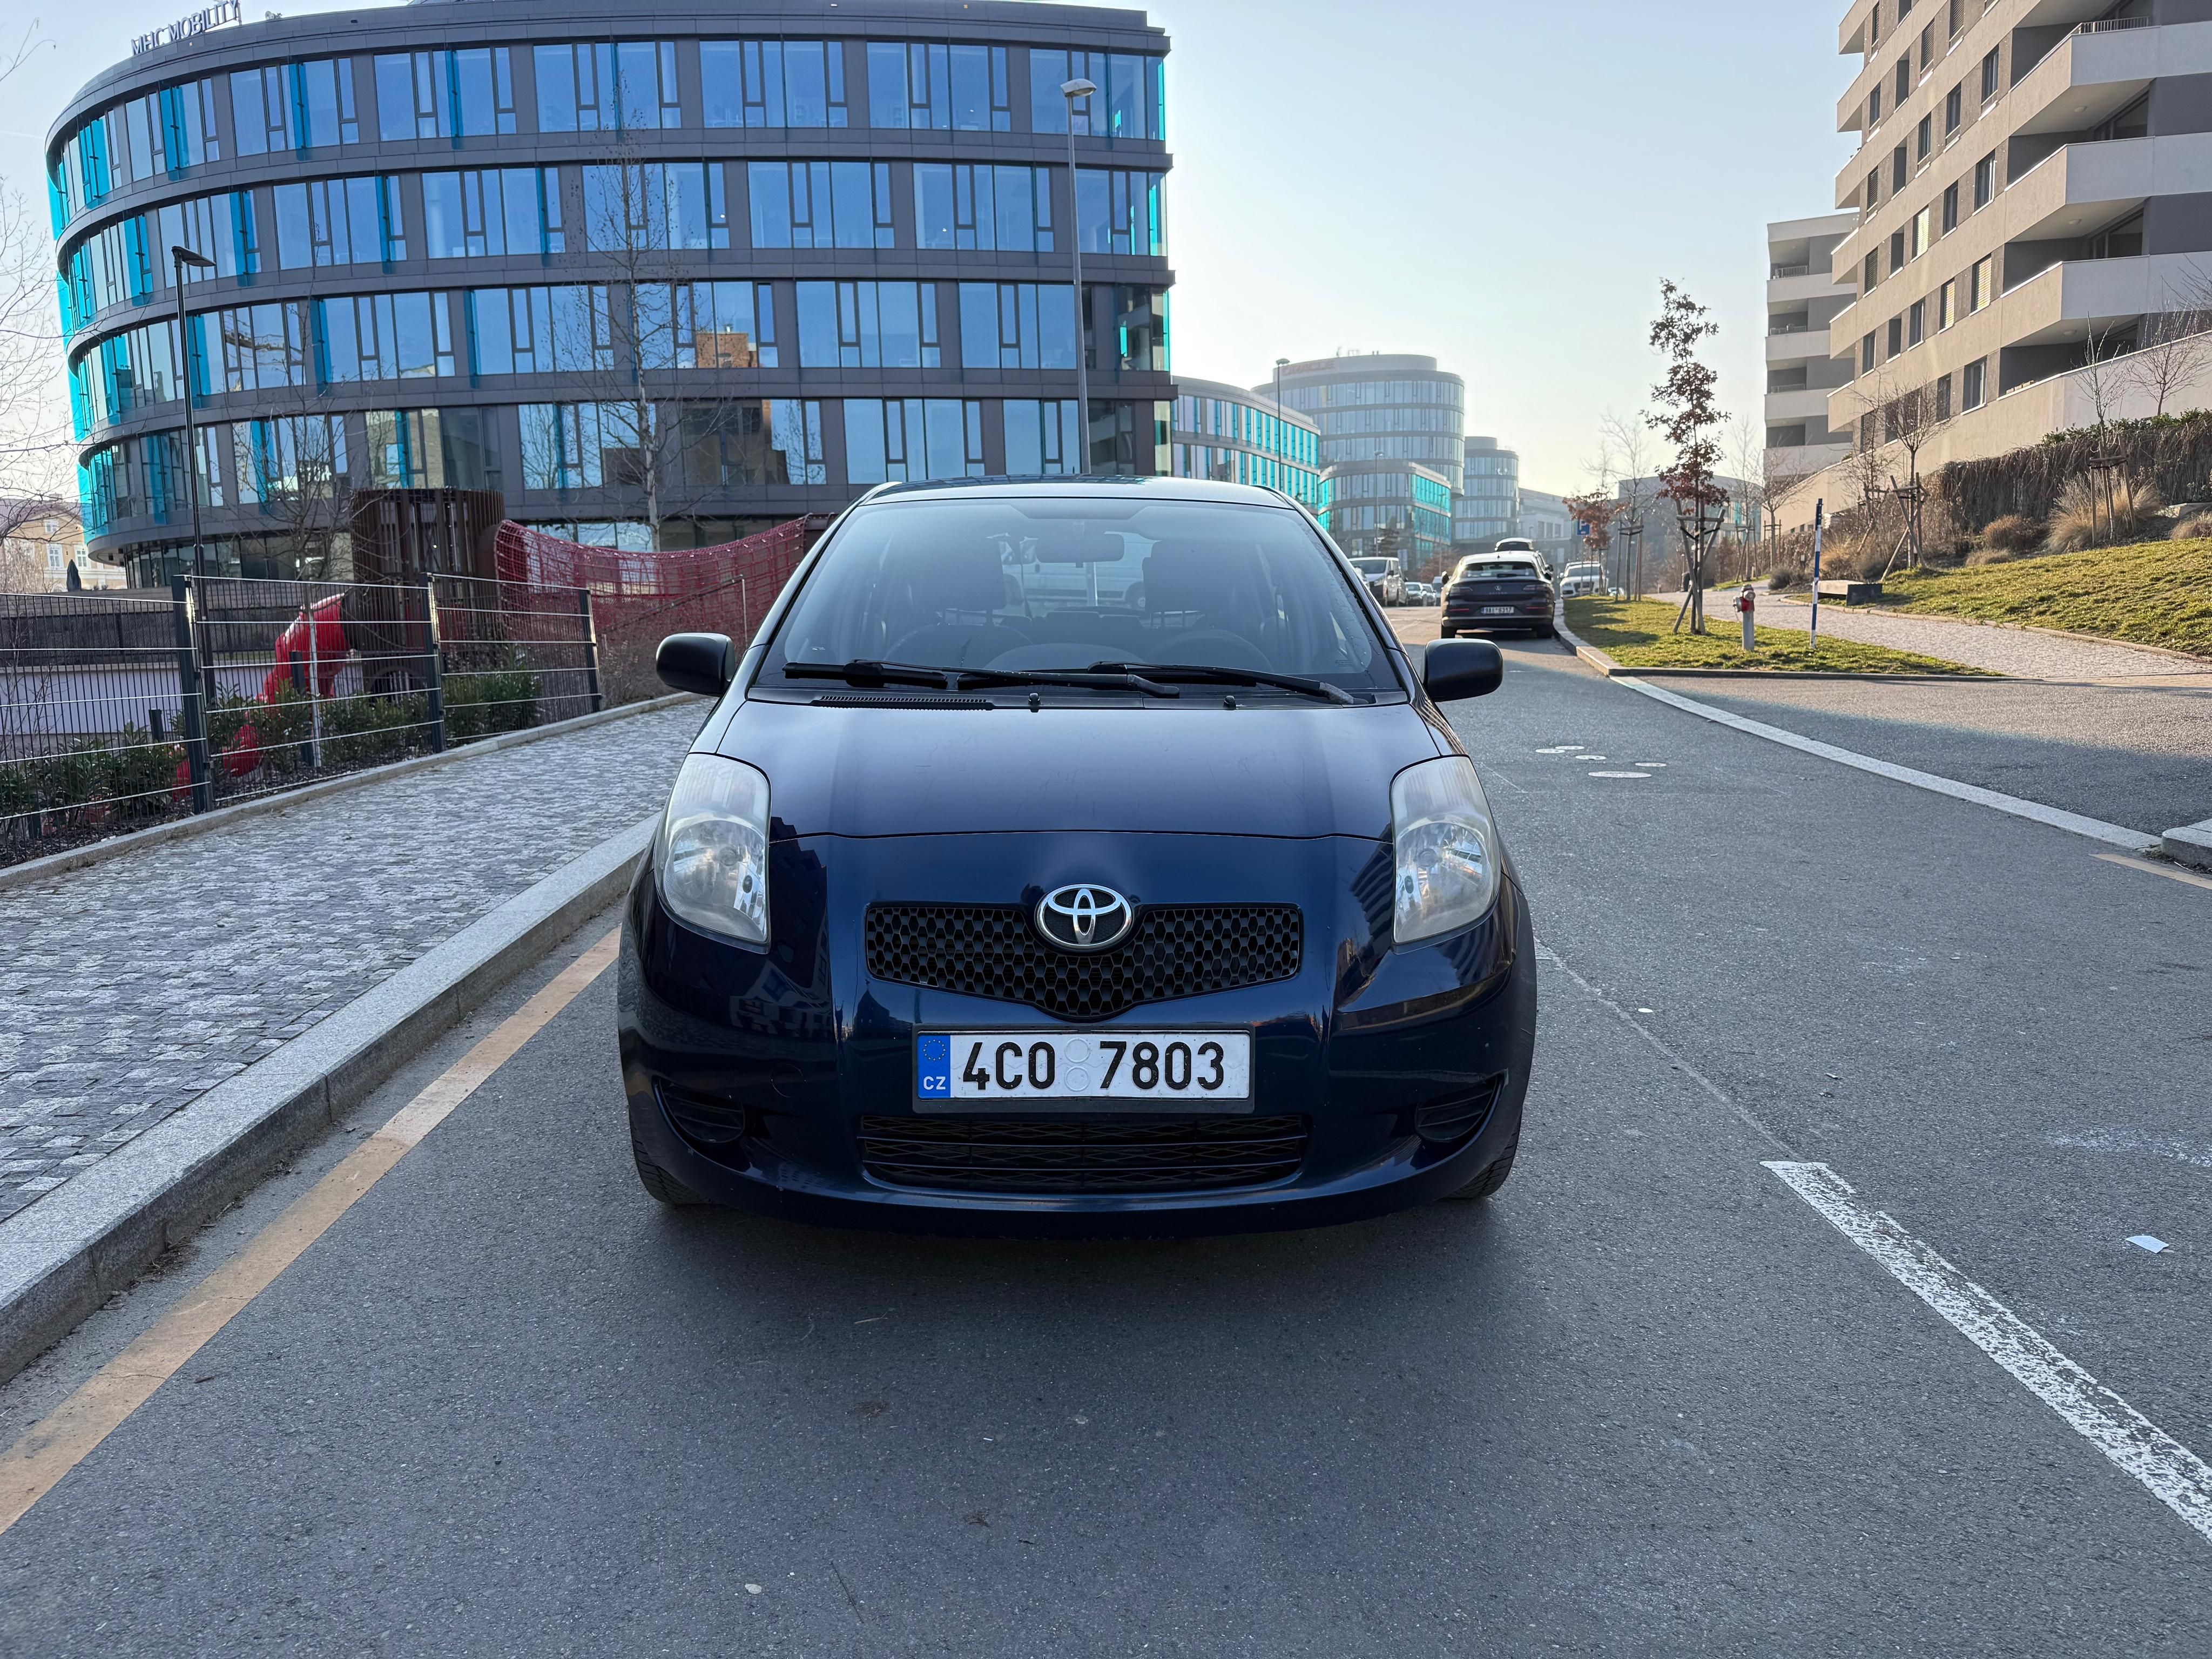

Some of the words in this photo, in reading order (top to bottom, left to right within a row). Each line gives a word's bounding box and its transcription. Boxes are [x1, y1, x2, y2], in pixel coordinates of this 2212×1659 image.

[131, 28, 164, 55] MHC
[168, 0, 239, 41] MOBILITY
[1282, 360, 1335, 376] ORACLE
[963, 1041, 1056, 1090] 4C0
[1100, 1041, 1224, 1090] 7803
[923, 1076, 946, 1090] CZ
